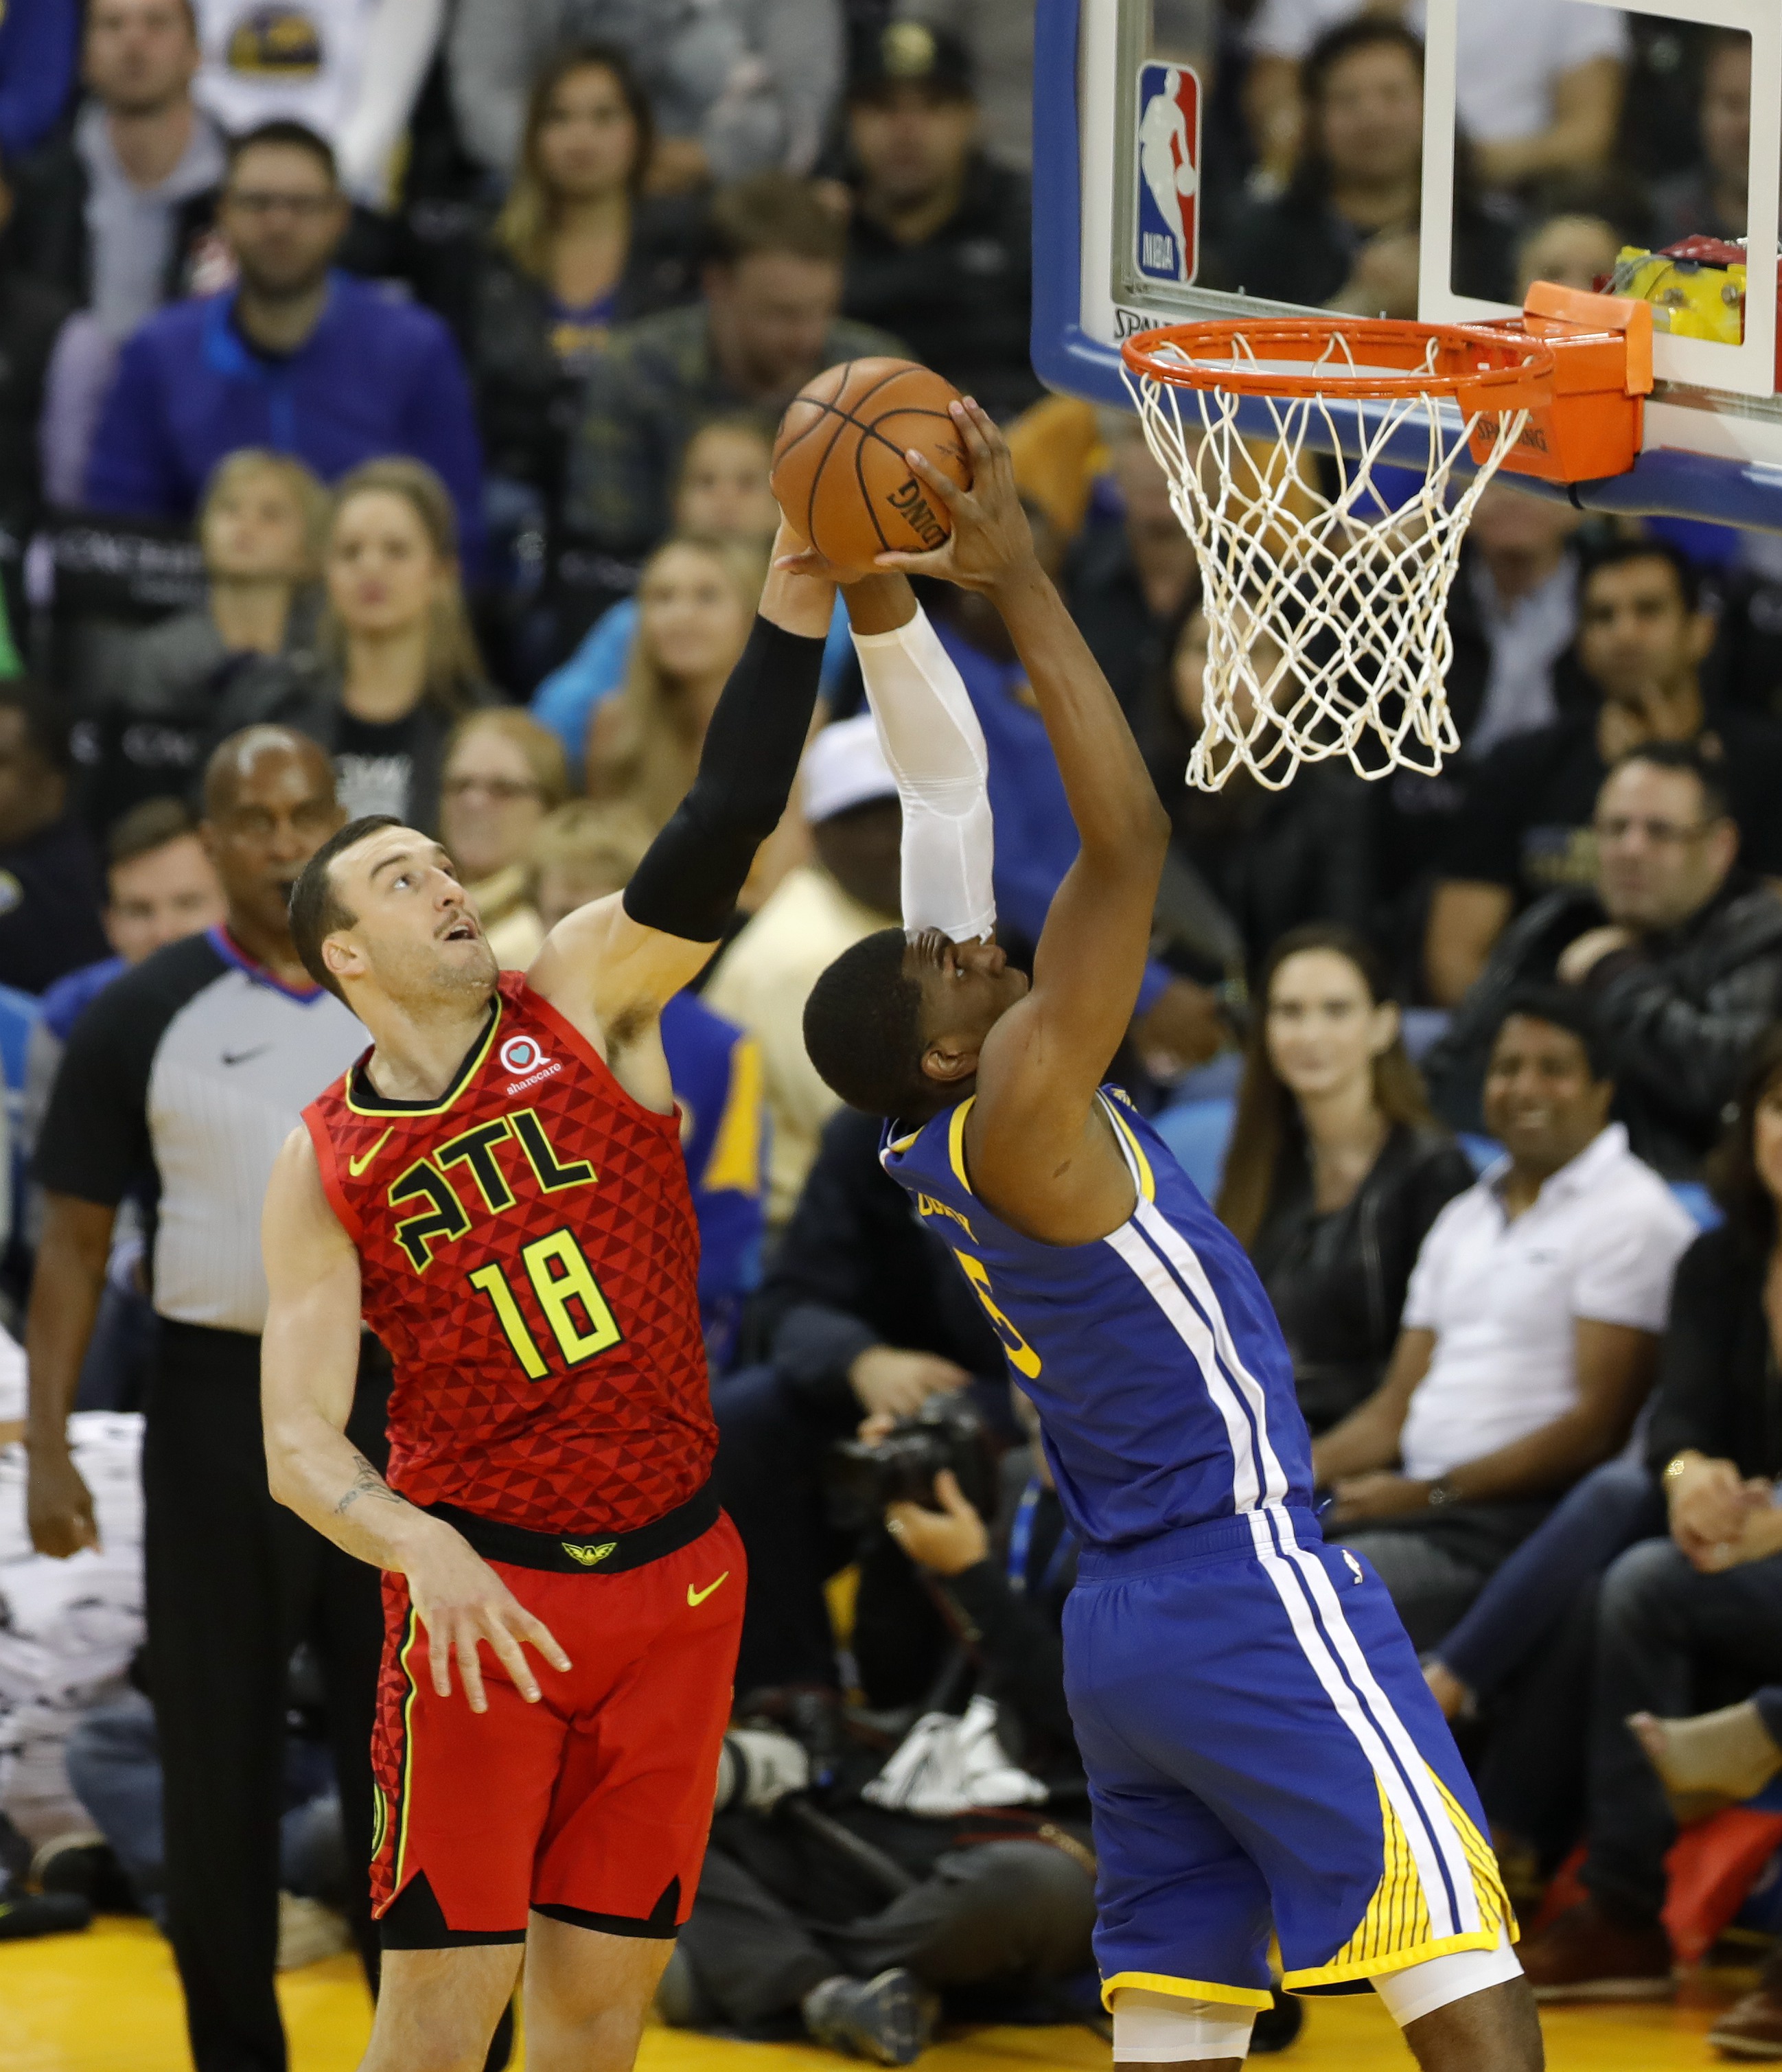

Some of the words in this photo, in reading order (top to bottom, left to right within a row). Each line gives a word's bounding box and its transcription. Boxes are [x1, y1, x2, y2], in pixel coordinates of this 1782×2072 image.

[1142, 231, 1174, 270] NBA
[507, 1063, 562, 1096] sharecare
[387, 1107, 599, 1276] ATL
[465, 1224, 625, 1383] 18
